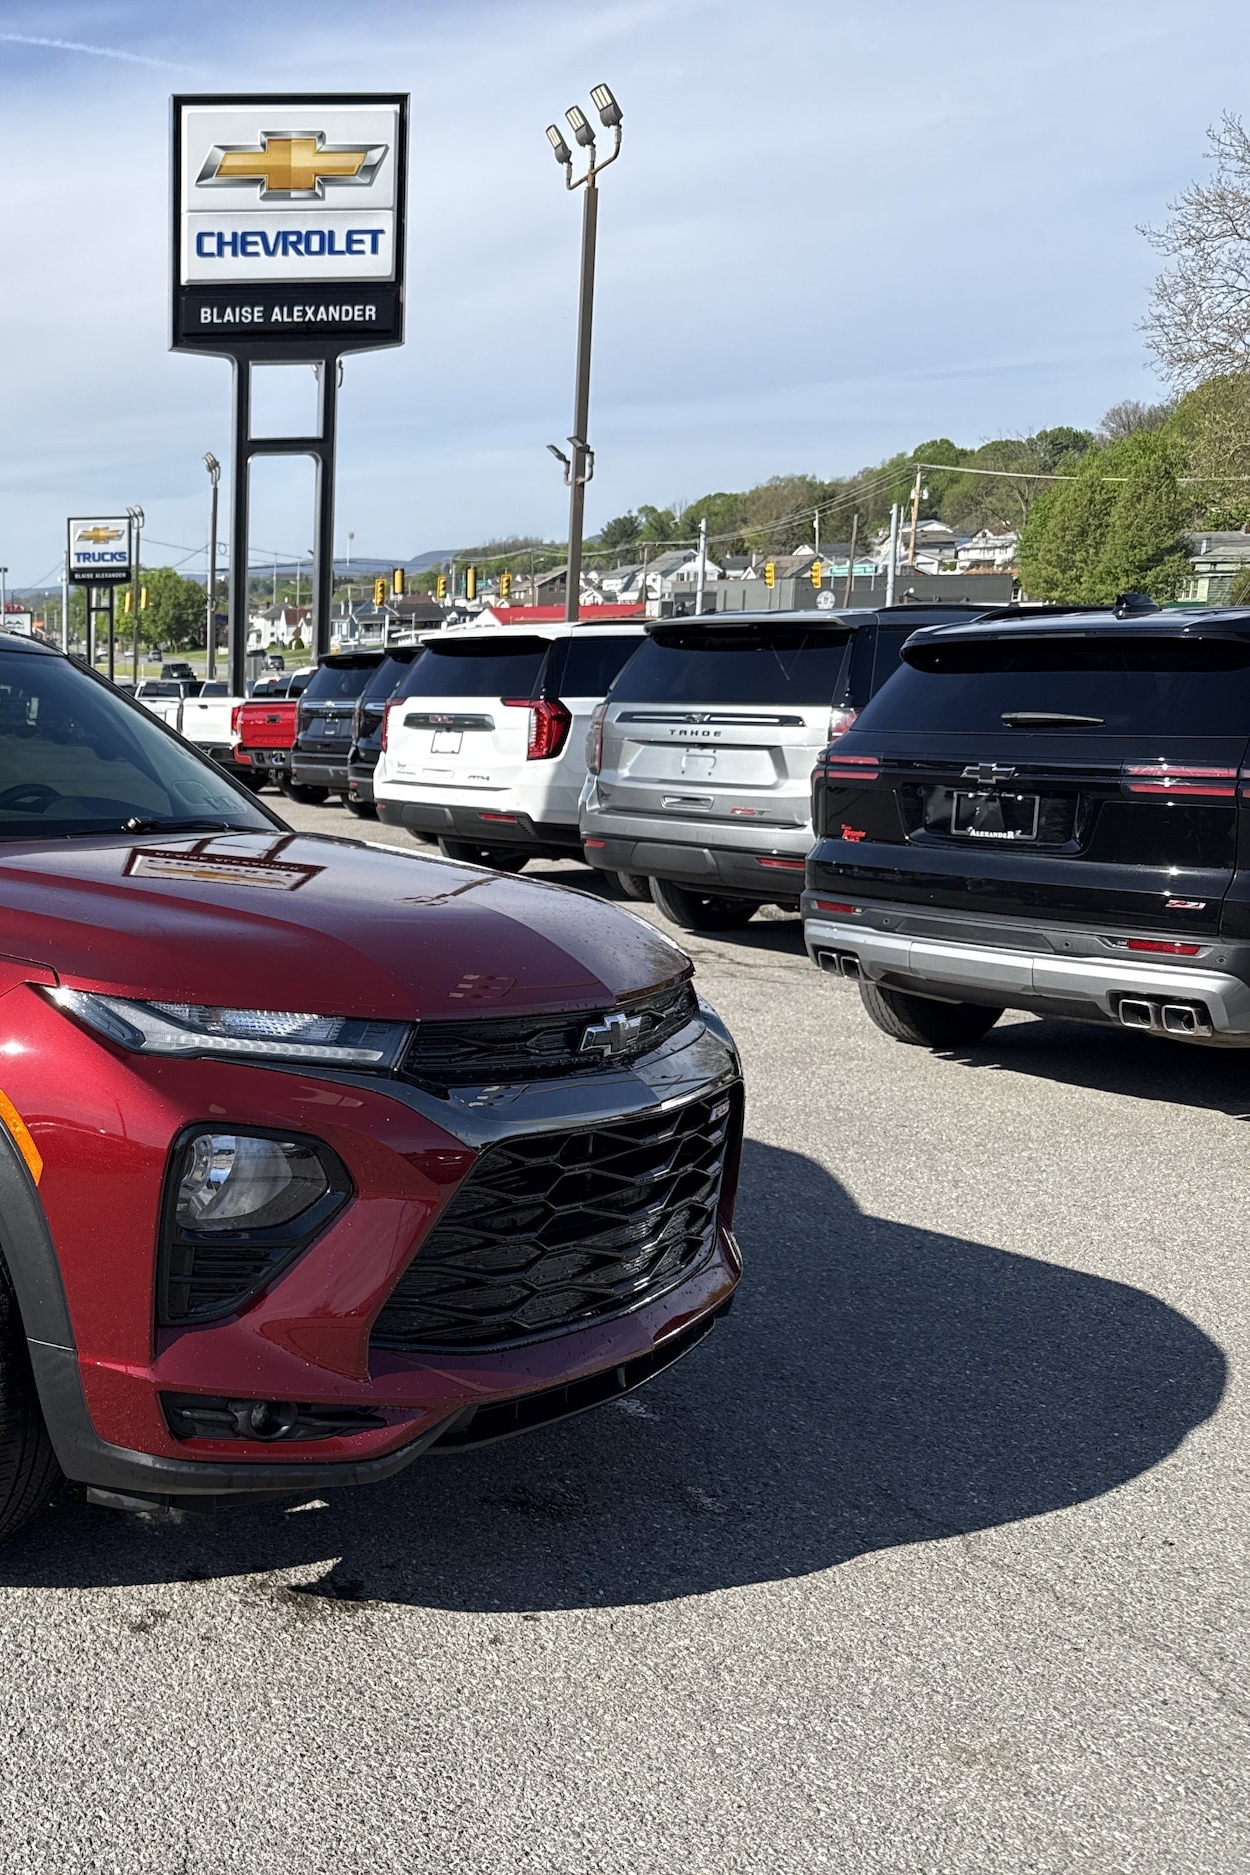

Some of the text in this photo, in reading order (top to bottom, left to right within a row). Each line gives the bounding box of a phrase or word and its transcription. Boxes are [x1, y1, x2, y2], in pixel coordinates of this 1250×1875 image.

[196, 229, 386, 257] CHEVROLET
[200, 305, 376, 324] BLAISE ALEXANDER
[74, 552, 127, 563] TRUCKS
[669, 729, 722, 737] TAHOE
